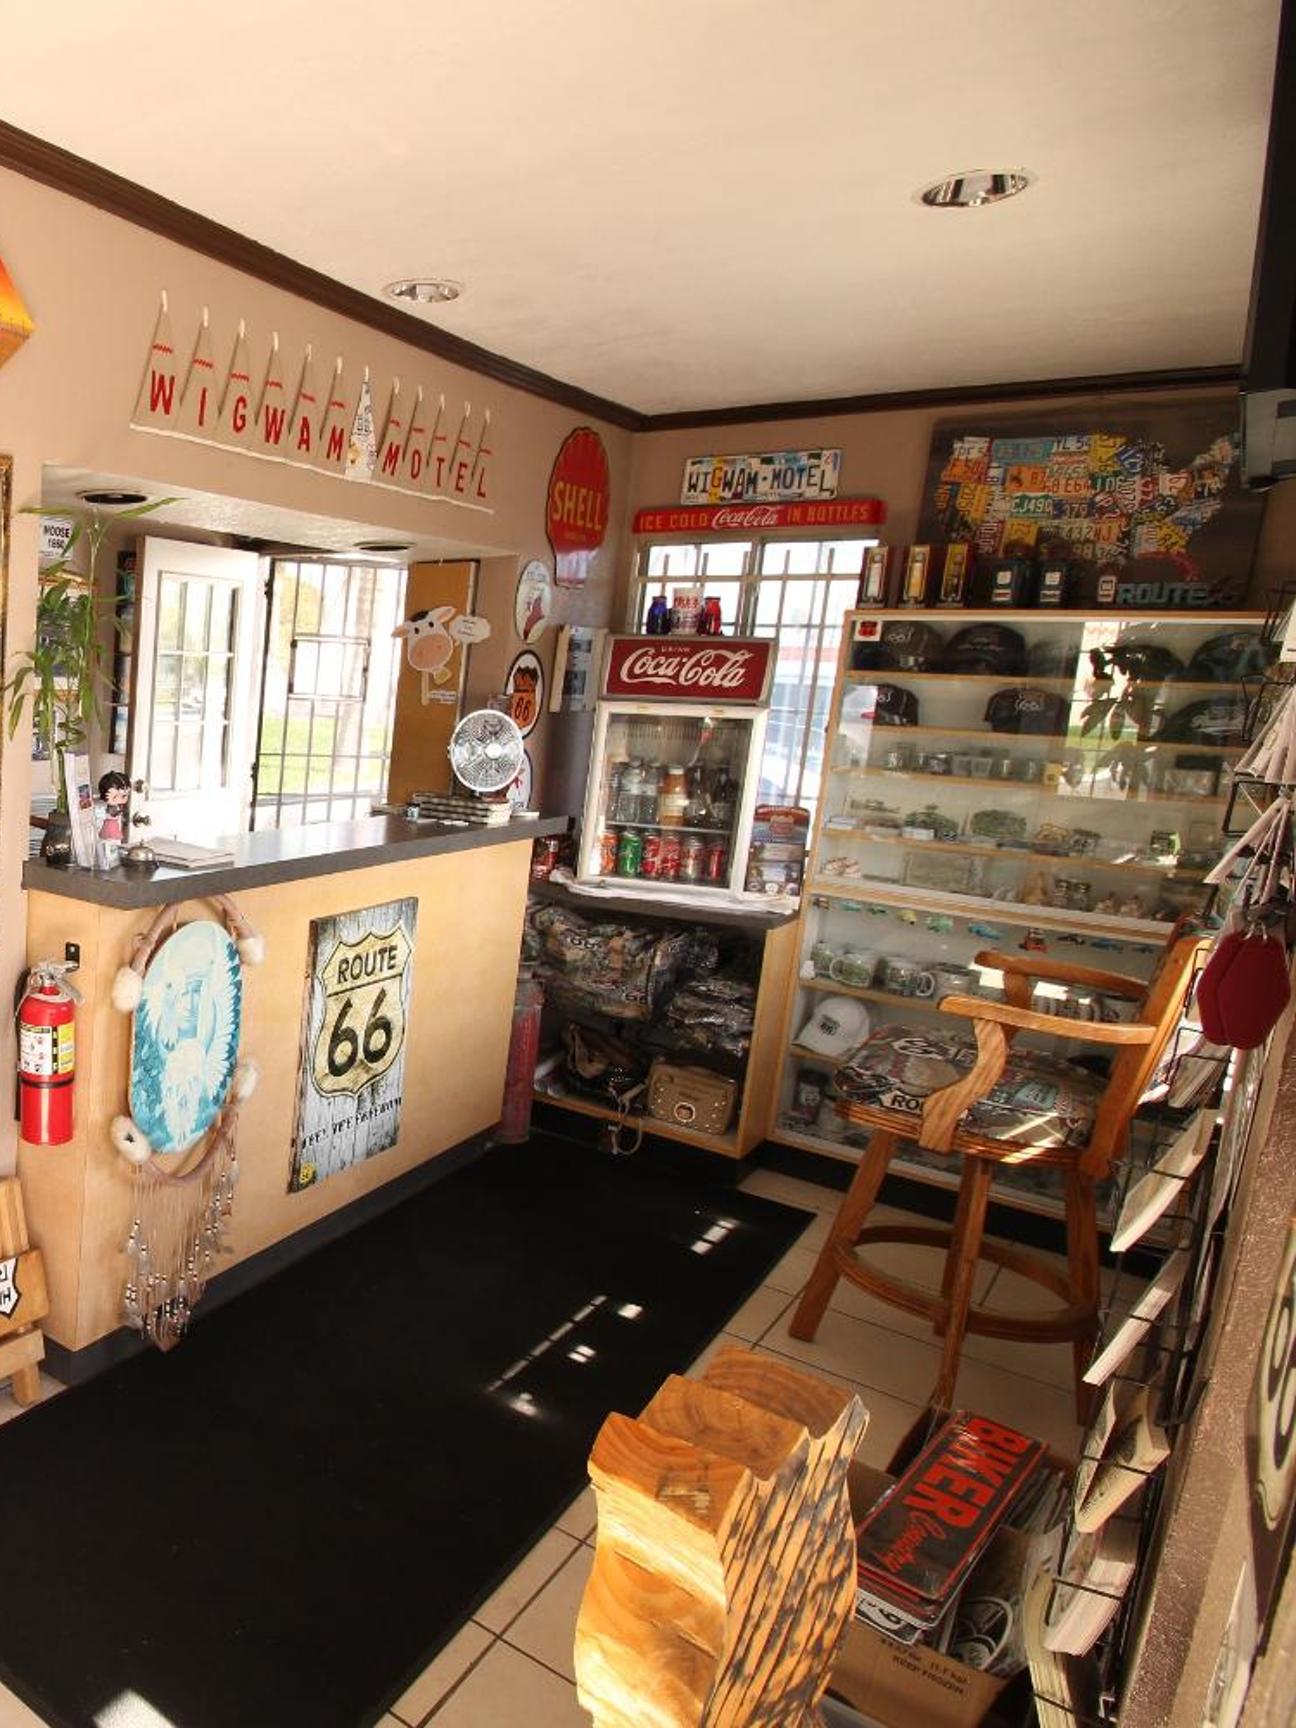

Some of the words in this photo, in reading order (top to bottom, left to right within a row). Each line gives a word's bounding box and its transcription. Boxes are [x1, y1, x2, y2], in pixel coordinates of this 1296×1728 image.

[150, 370, 344, 462] WIGWAM
[382, 441, 487, 498] MOTEL
[552, 480, 603, 531] SHELL
[640, 513, 664, 531] ICE
[669, 512, 707, 529] COLD
[711, 505, 782, 530] Coca-Cola
[787, 507, 801, 523] IN
[807, 502, 869, 522] BOTTLES
[619, 647, 753, 688] Coca-Cola
[514, 697, 531, 721] 66
[337, 945, 399, 985] ROUTE
[328, 987, 394, 1077] 66
[903, 1416, 1031, 1529] BIKER
